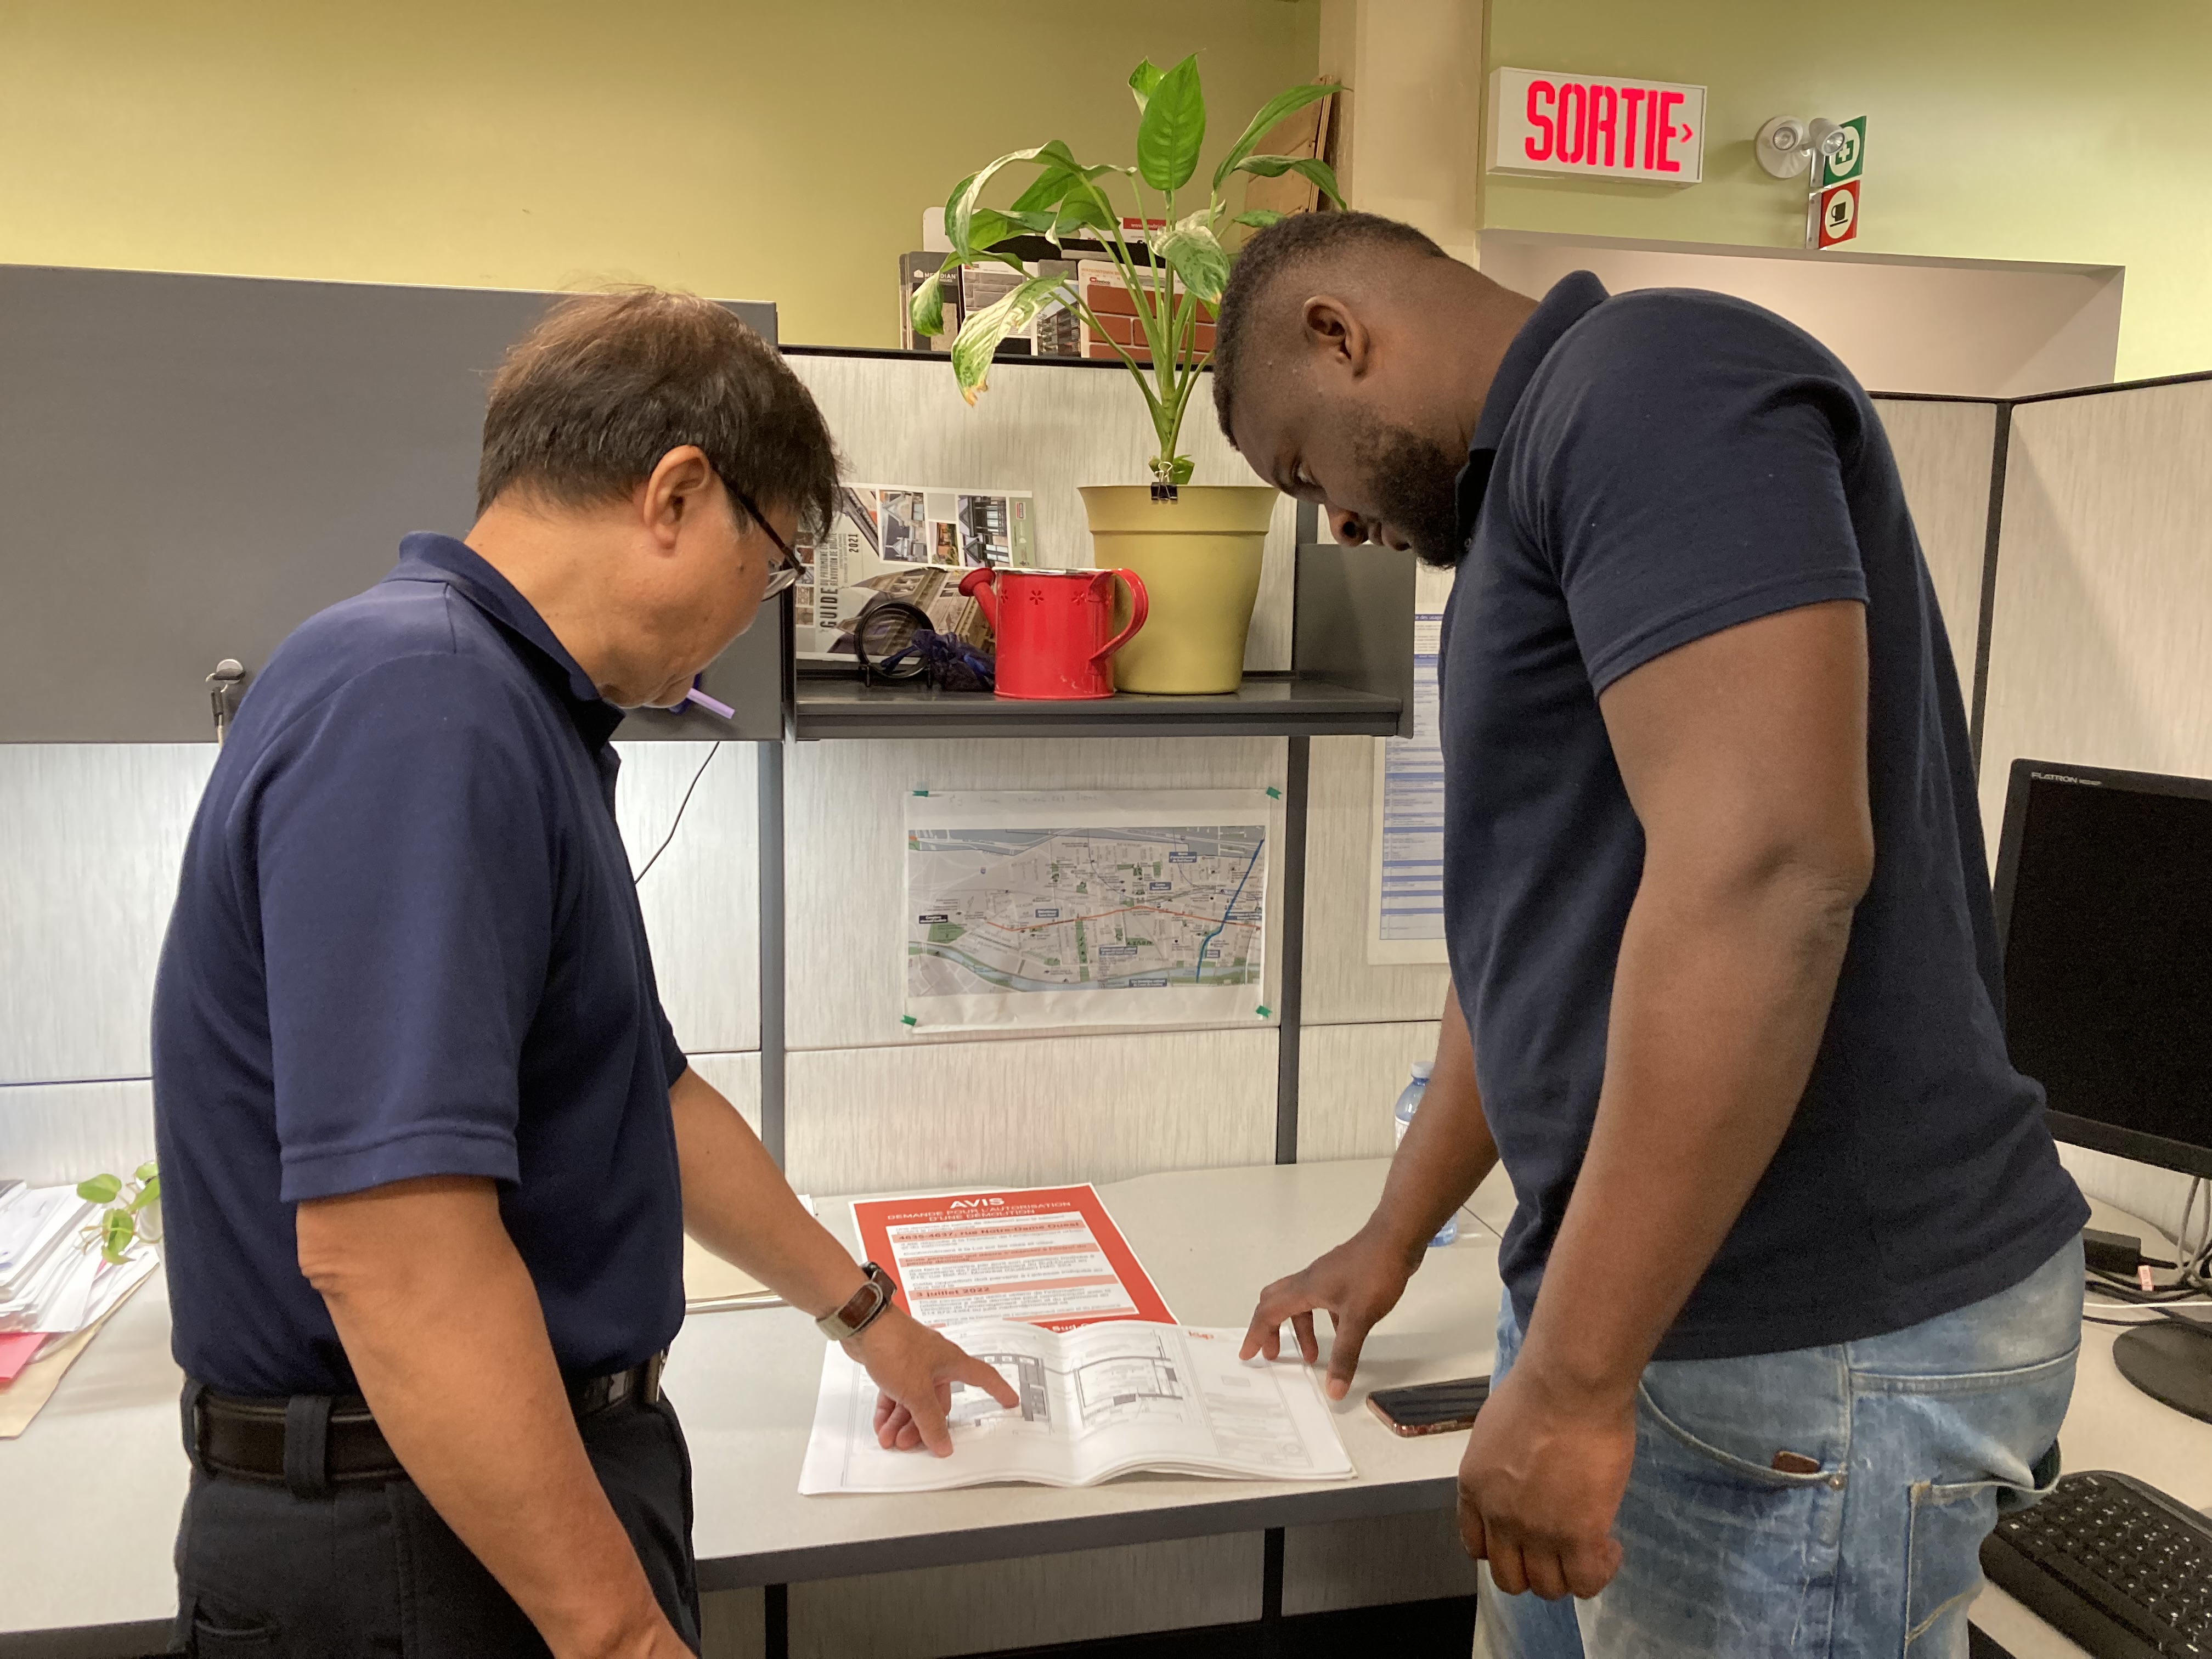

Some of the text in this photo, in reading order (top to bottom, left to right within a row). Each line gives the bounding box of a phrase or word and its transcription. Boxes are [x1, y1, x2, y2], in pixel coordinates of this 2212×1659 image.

[1524, 80, 1685, 173] SORTIE
[848, 534, 859, 553] 2021
[820, 588, 838, 628] GUIDE
[2032, 772, 2078, 783] FLATRON
[888, 1211, 944, 1220] DEMANDE
[981, 1202, 1071, 1212] L'AUTORISATION
[950, 1198, 1005, 1209] AVIS
[981, 1225, 1045, 1234] Notre-Dame
